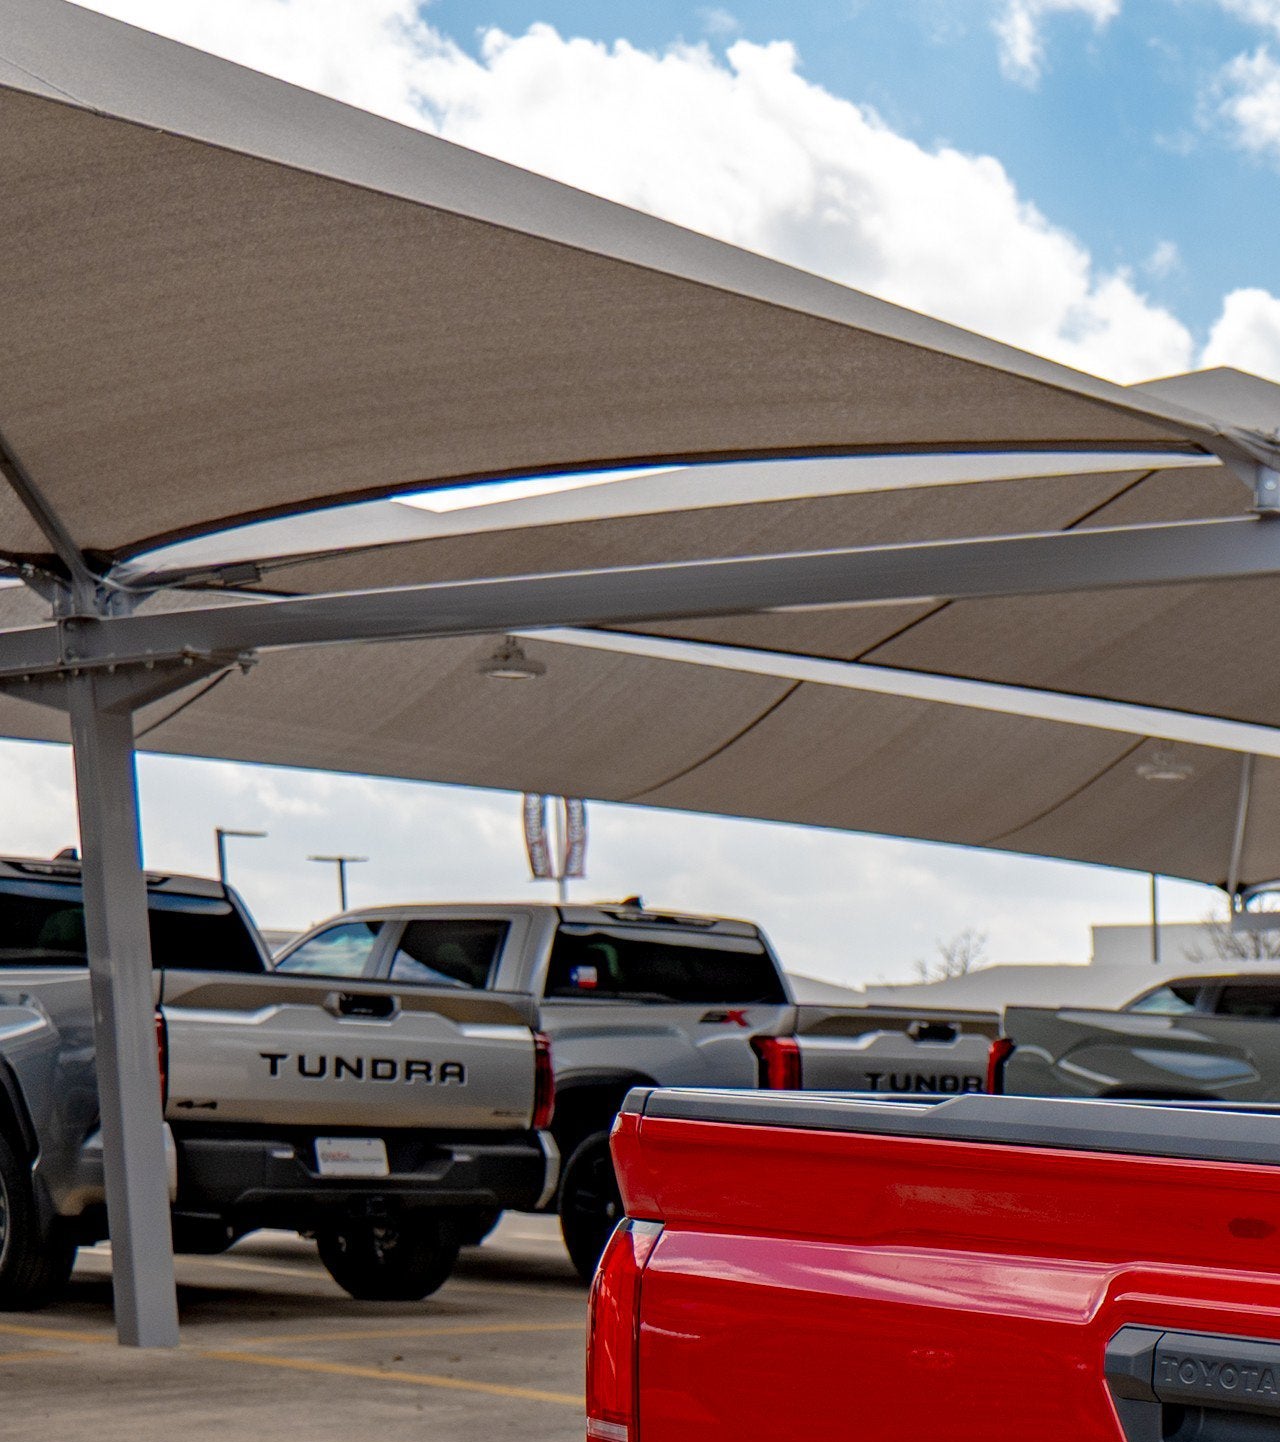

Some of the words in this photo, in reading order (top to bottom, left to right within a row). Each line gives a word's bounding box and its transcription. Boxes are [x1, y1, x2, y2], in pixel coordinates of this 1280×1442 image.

[259, 1052, 469, 1086] TUNDRA
[864, 1072, 983, 1093] TUNDR
[1161, 1356, 1279, 1396] TOYOTA
